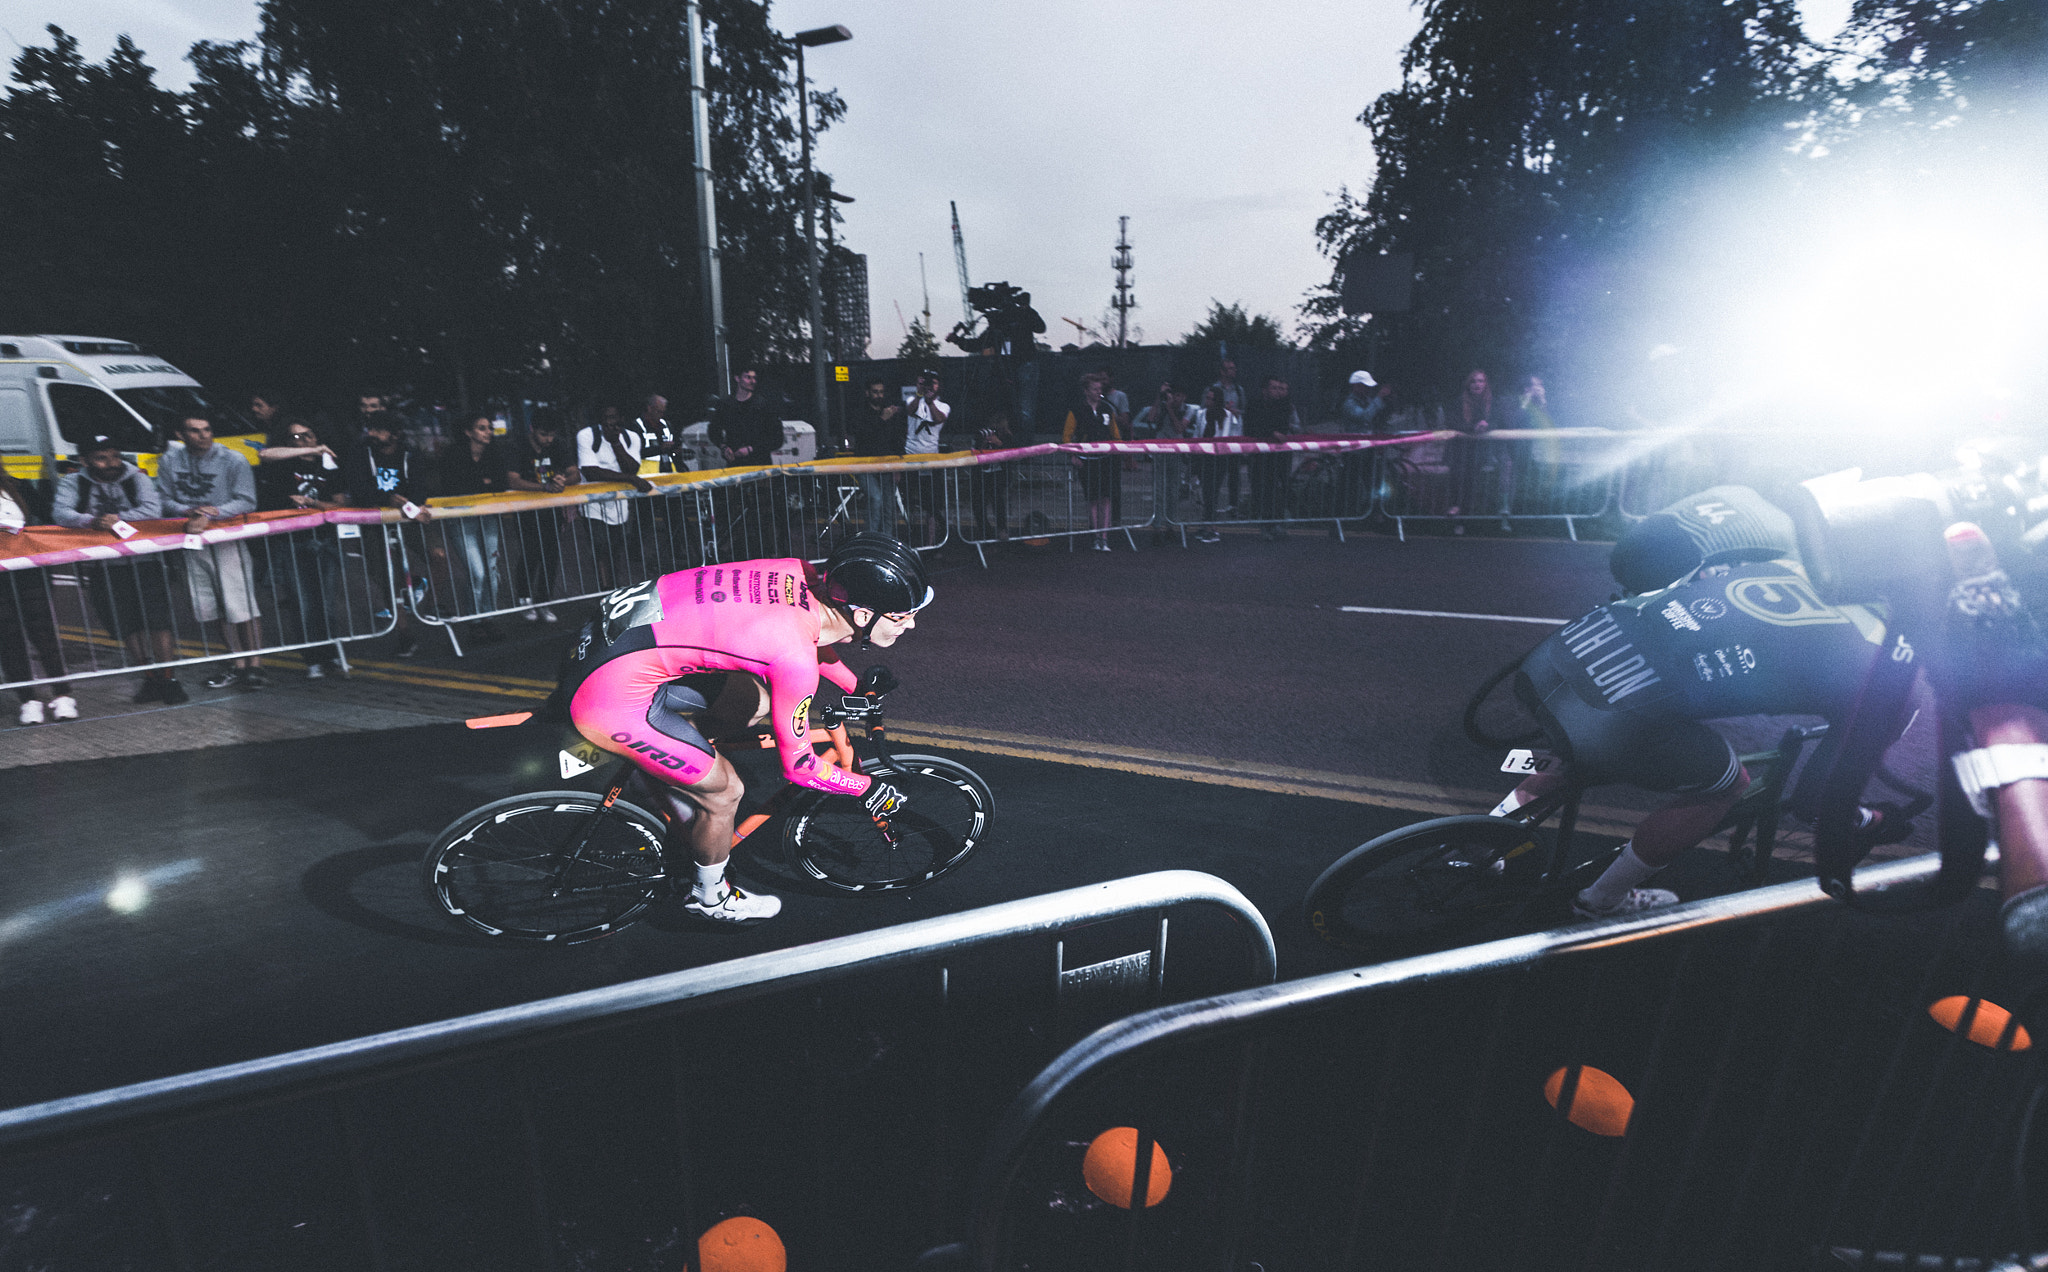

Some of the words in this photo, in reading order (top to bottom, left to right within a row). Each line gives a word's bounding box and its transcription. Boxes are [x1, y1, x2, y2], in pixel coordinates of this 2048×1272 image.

[609, 580, 652, 620] 36
[768, 571, 780, 604] NILOX
[1661, 608, 1687, 631] COFFEE
[1667, 599, 1702, 632] WORKSHOP
[1585, 642, 1662, 705] LDN
[577, 748, 600, 768] 36
[839, 779, 865, 791] areas
